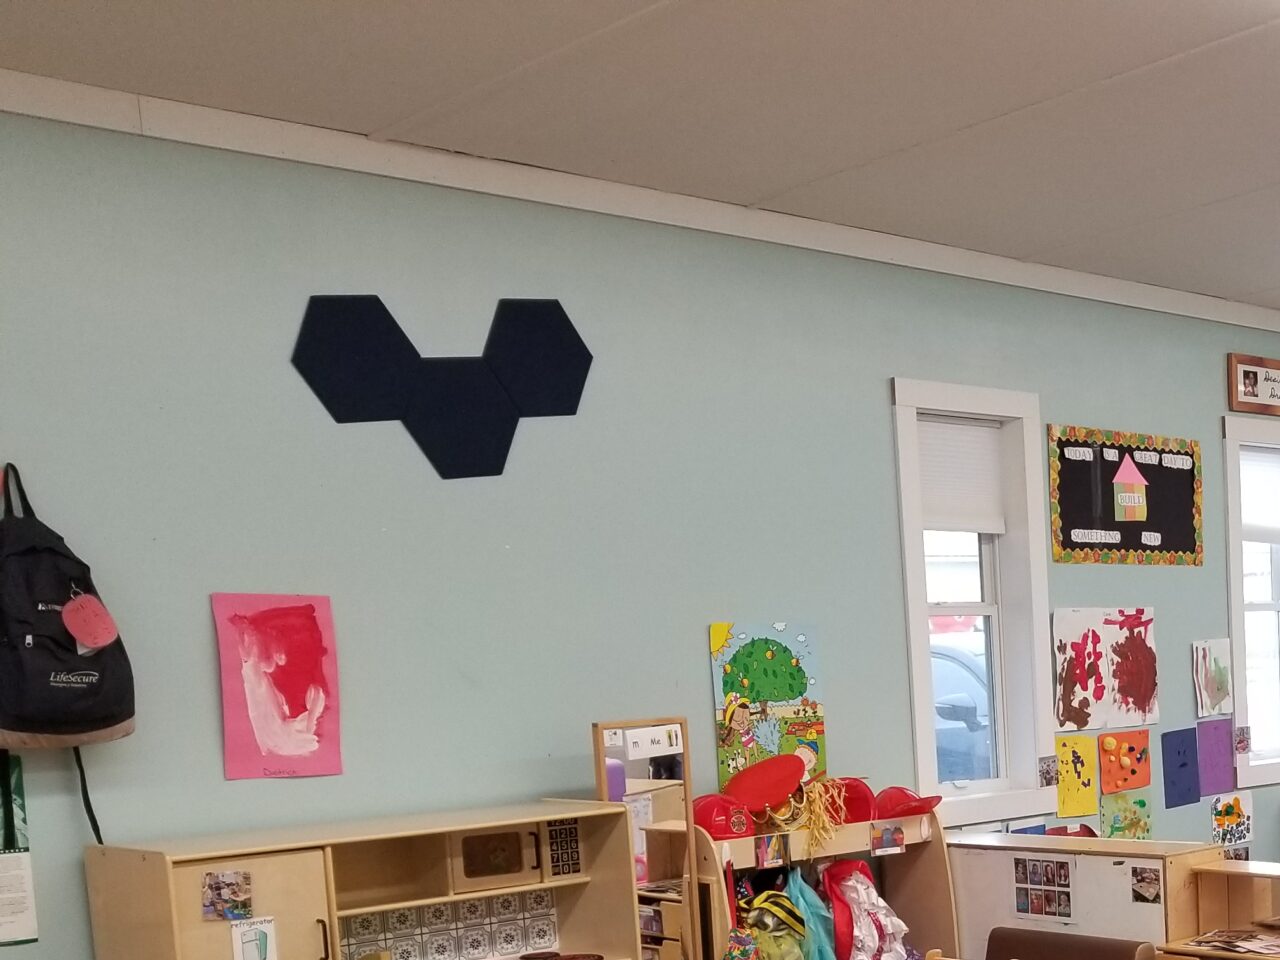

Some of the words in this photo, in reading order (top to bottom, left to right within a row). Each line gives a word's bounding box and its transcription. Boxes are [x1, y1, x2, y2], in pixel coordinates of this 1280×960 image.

[1066, 448, 1093, 460] TODAY
[1112, 450, 1119, 459] A
[1134, 452, 1158, 464] GREAT
[1163, 455, 1178, 465] DAY
[1180, 456, 1192, 467] TO
[1119, 494, 1144, 504] BUILD
[1072, 530, 1120, 542] SOMETHING
[1143, 533, 1160, 543] NEW
[50, 671, 99, 683] LifeSecure
[650, 738, 661, 746] Me
[231, 918, 274, 929] refrigerator
